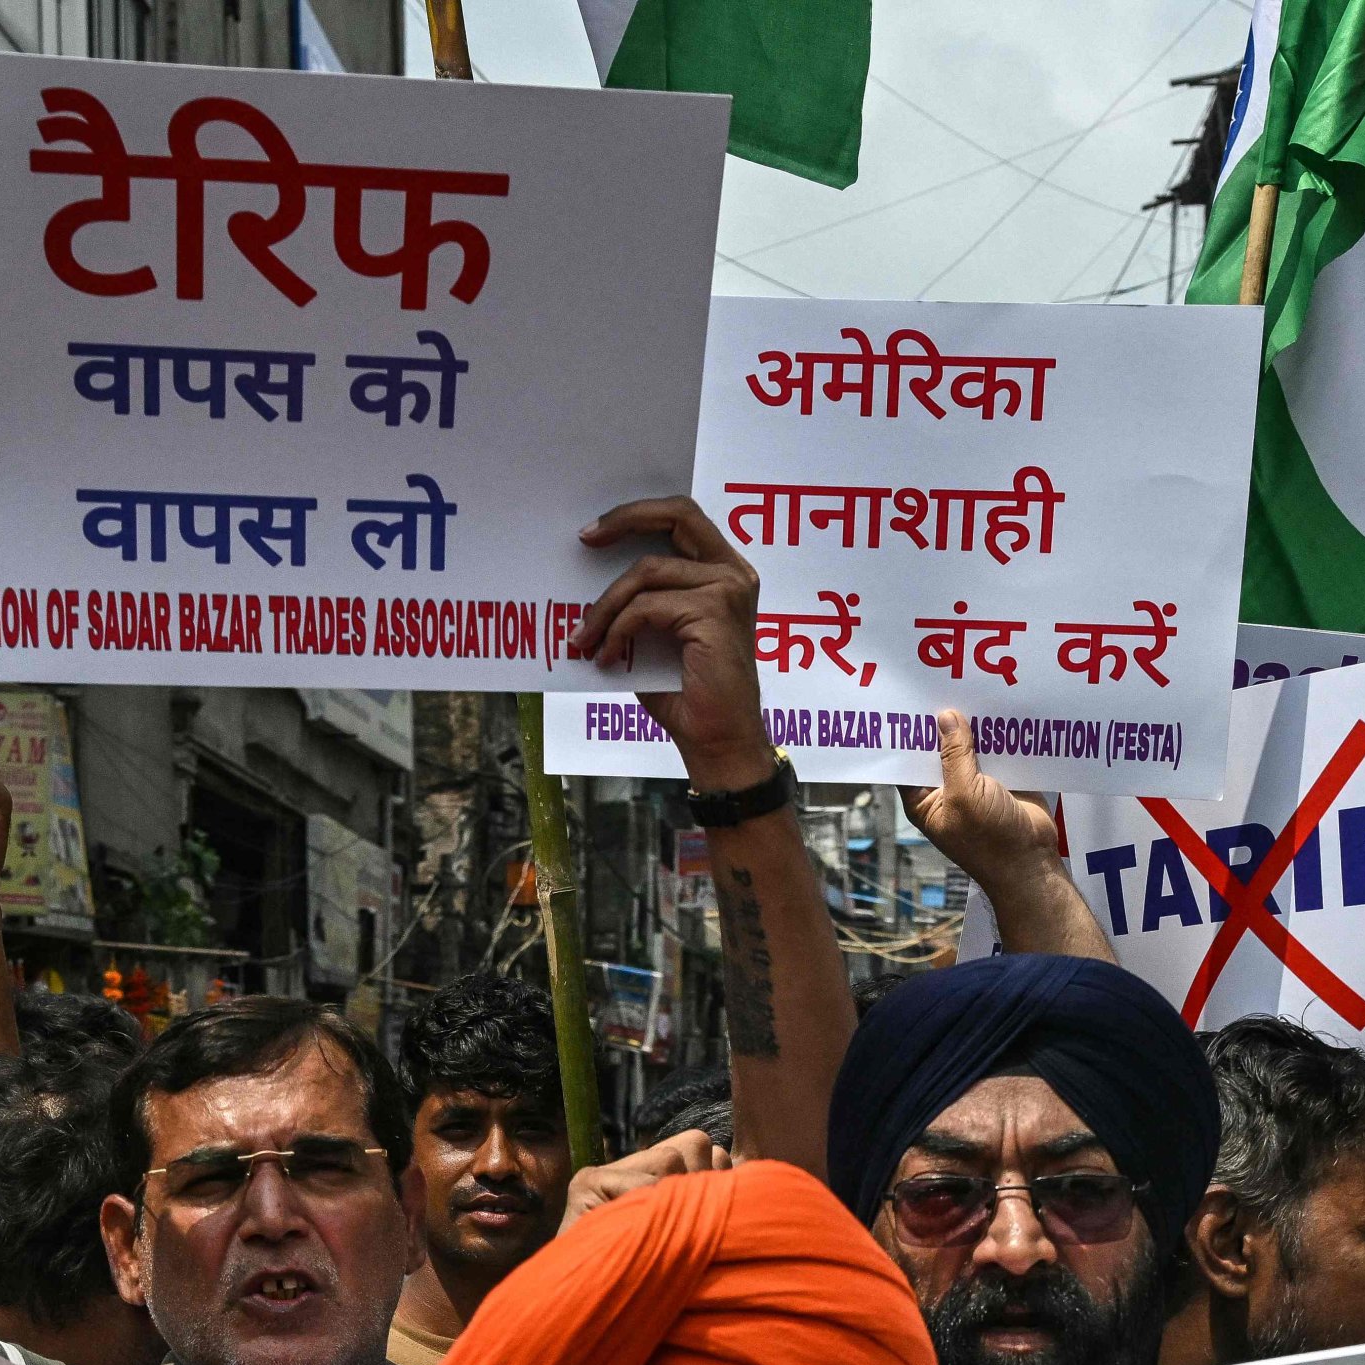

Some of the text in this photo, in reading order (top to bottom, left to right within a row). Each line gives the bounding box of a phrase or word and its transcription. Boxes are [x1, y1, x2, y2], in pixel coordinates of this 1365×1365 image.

[30, 86, 510, 311] टैरिफ
[67, 329, 469, 430] वापस को
[745, 328, 1056, 422] अमेरिका
[76, 473, 457, 572] वापस लो
[725, 466, 1065, 566] तानाशाही
[46, 588, 79, 651] OF
[87, 588, 172, 652] SADAR
[179, 591, 263, 654] BAZAR
[269, 595, 366, 656] TRADES
[373, 598, 537, 659] ASSOCIATION
[915, 600, 1027, 686] बंद
[1055, 600, 1177, 689] करें
[762, 708, 812, 747] ADAR
[818, 709, 882, 749] BAZAR
[887, 712, 942, 753] TRAD
[1105, 721, 1183, 770] (FESTA)
